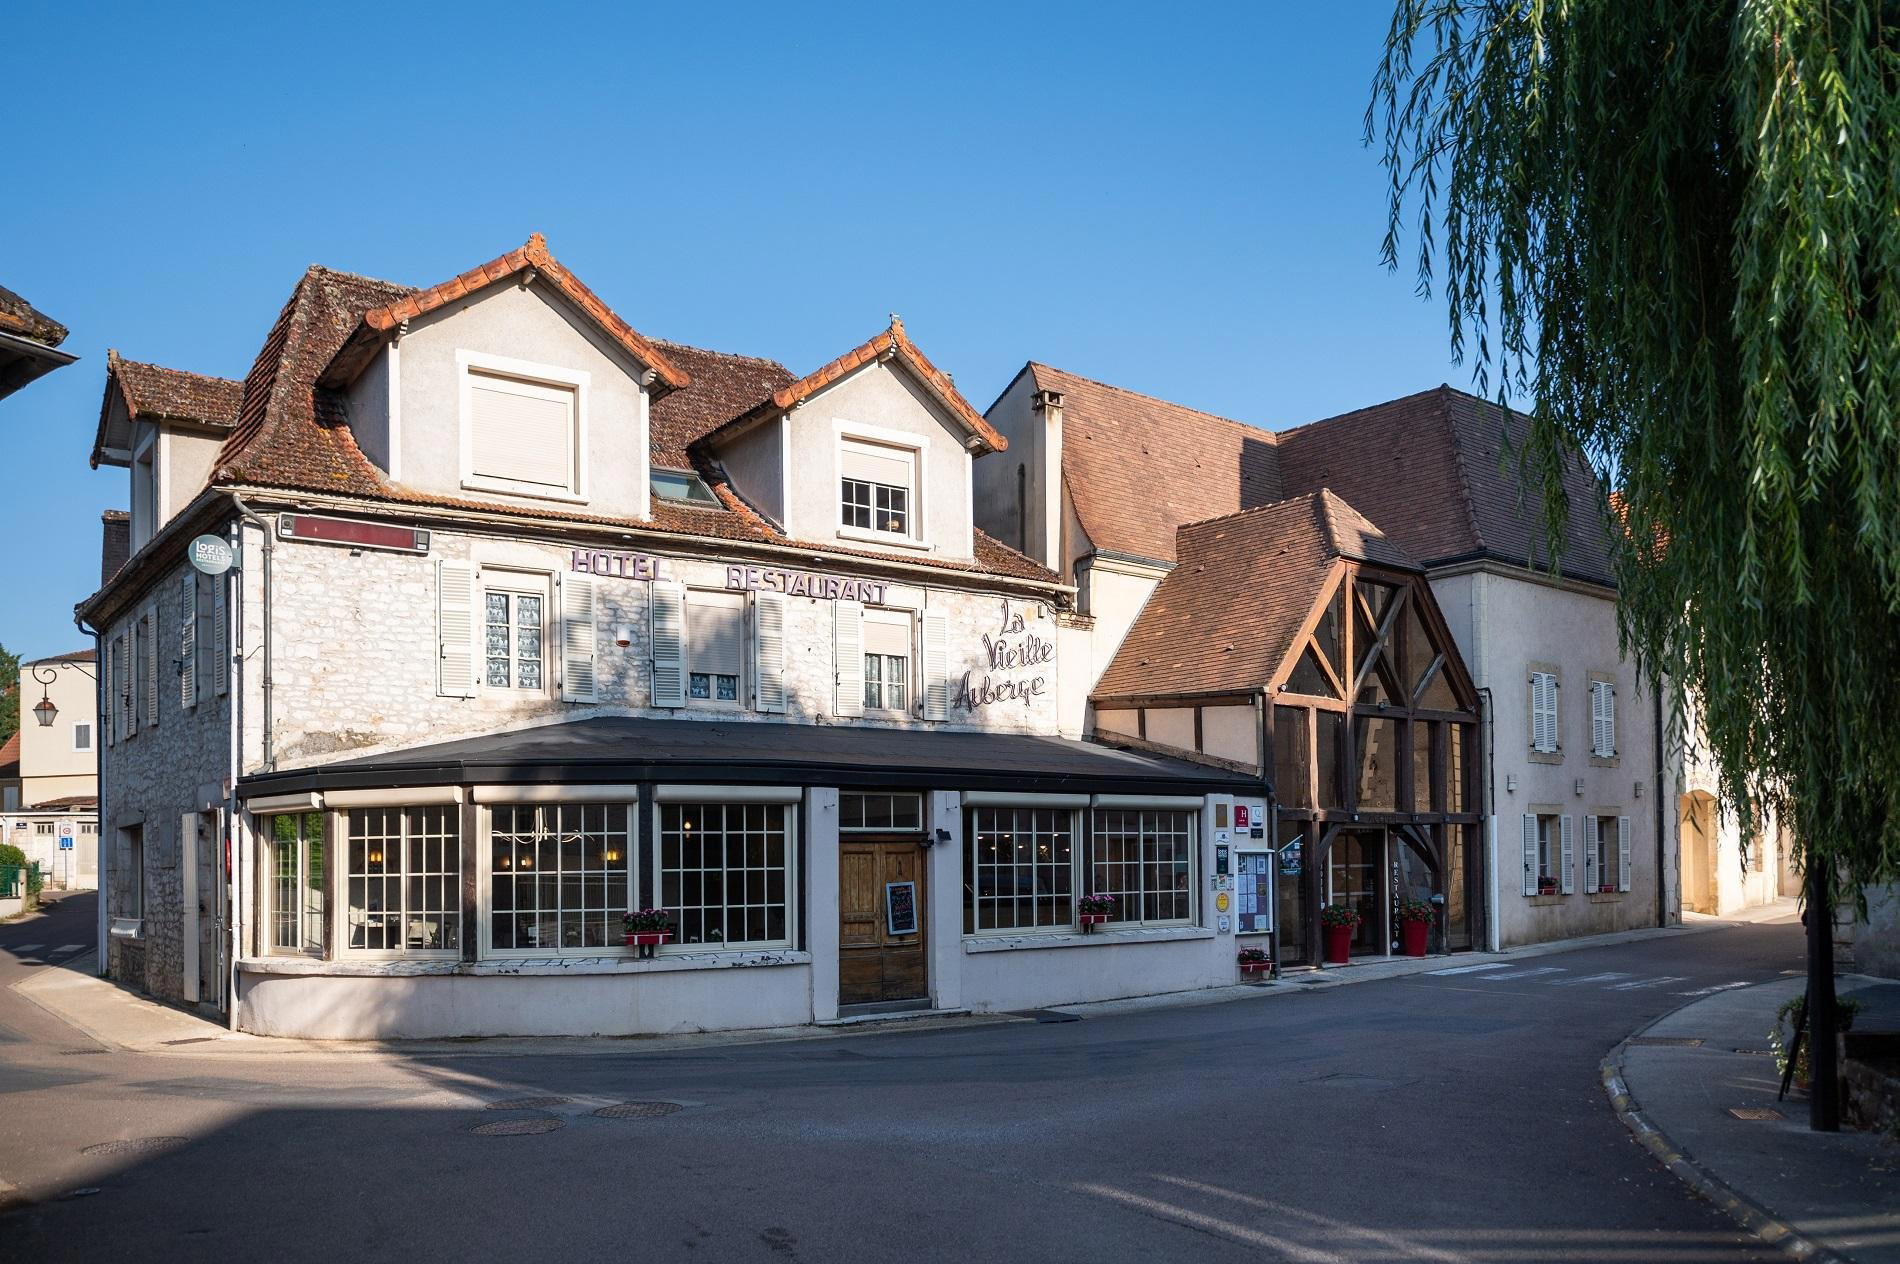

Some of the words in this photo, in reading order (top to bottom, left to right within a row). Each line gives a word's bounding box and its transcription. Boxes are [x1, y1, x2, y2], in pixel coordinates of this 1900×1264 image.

[571, 547, 671, 582] HOTEL
[726, 563, 891, 605] RESTAURANT
[1000, 599, 1025, 636] La
[981, 633, 1056, 672] Vieille
[953, 671, 1045, 713] Auberge
